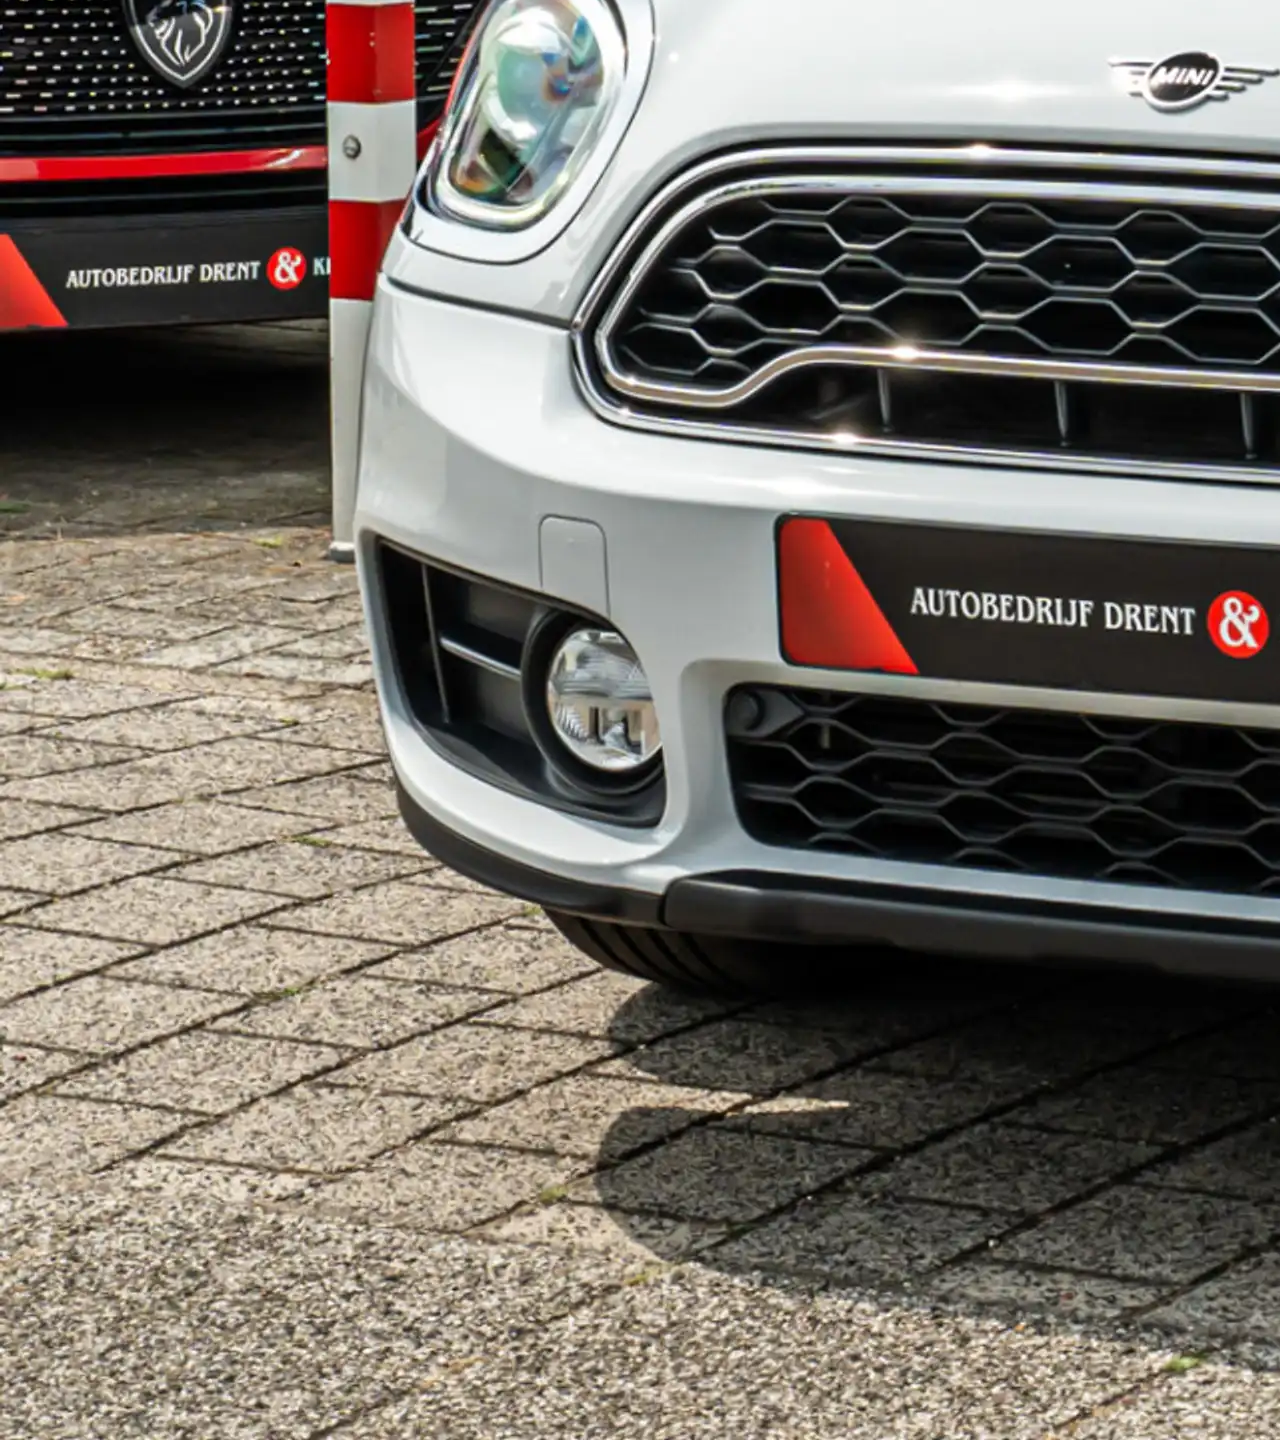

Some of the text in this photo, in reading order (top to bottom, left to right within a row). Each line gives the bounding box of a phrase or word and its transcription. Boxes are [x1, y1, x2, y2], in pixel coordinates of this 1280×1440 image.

[1150, 65, 1215, 86] MINI
[65, 264, 194, 289] AUTOBEDRIJF
[199, 261, 261, 283] DRENT
[273, 251, 302, 284] &
[910, 586, 1094, 628] AUTOBEDRIJF
[1104, 601, 1197, 636] DRENT
[1219, 596, 1261, 649] &
